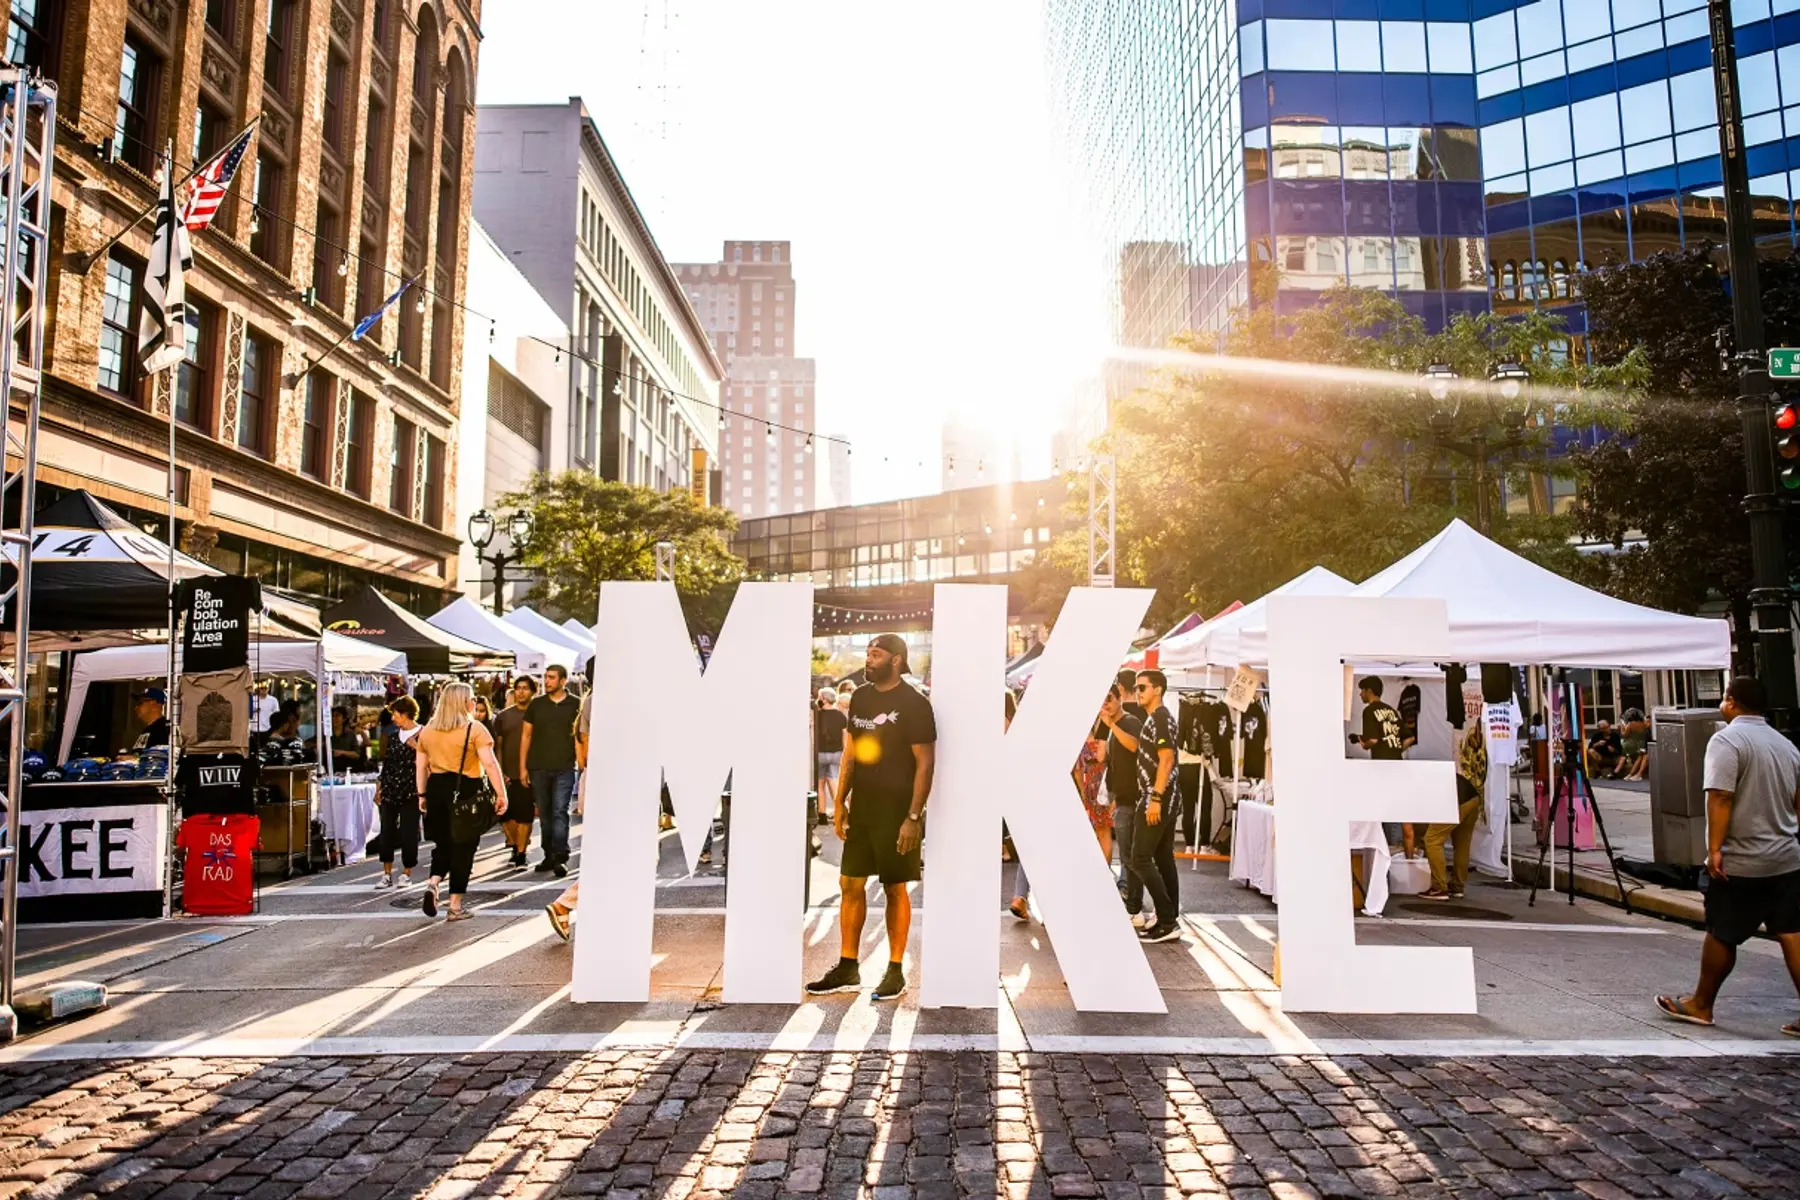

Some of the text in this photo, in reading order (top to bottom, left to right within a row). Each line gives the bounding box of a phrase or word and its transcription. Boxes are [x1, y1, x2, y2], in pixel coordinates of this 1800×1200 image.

[194, 588, 212, 600] Re
[194, 599, 223, 609] com
[193, 608, 219, 620] bob
[193, 618, 239, 631] ulation
[191, 631, 223, 643] Area
[571, 579, 1477, 1015] MKE
[209, 831, 233, 847] DAS
[0, 817, 134, 883] KEE
[202, 866, 234, 881] RAD
